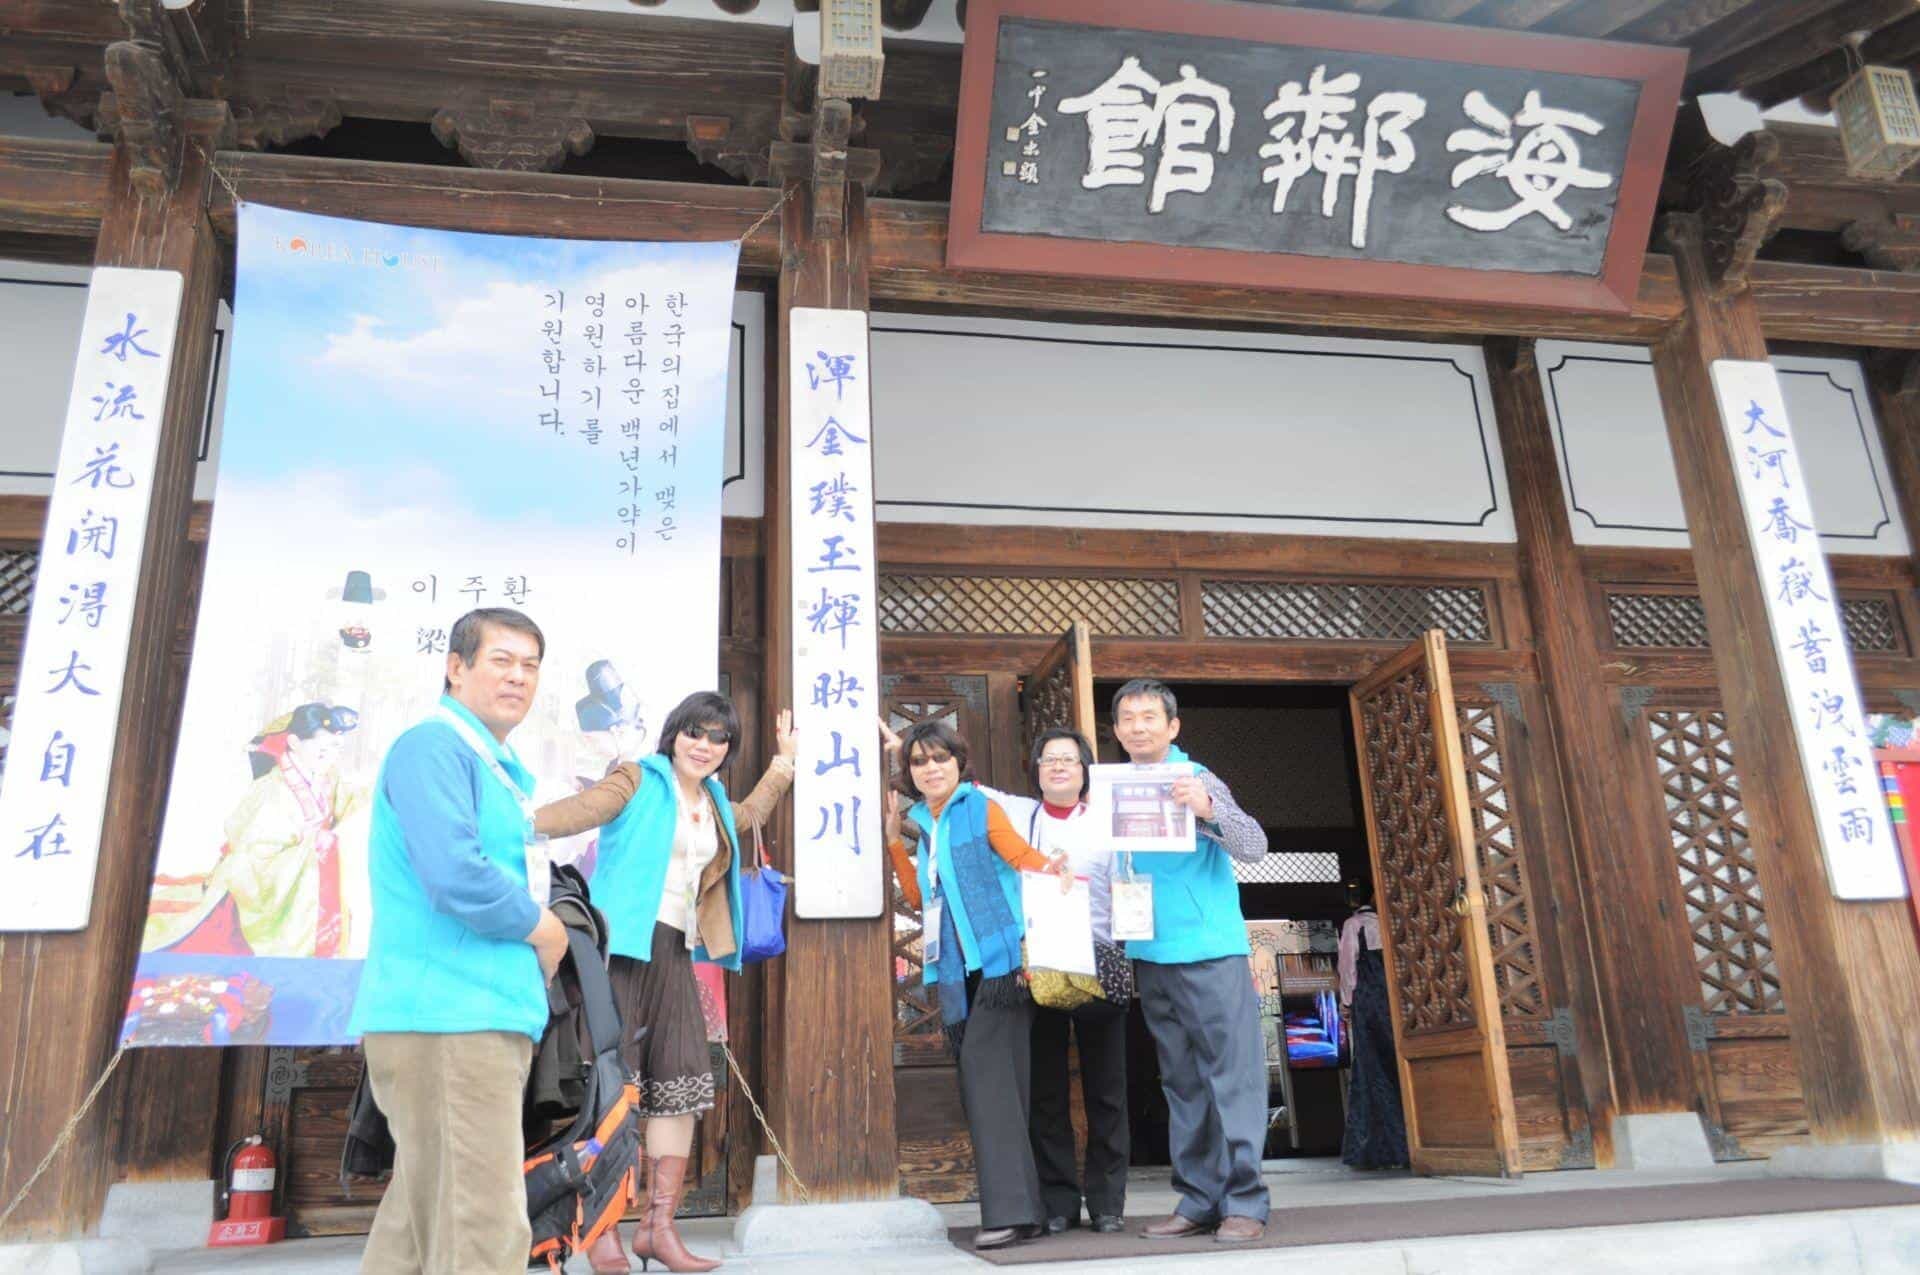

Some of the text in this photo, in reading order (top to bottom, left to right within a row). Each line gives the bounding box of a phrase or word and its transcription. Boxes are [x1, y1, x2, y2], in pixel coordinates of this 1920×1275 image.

[537, 288, 567, 437] 기원합니다.
[577, 291, 607, 446] 영원하기를
[614, 291, 651, 556] 아름다운 백년가약이
[653, 484, 679, 542] 맺은
